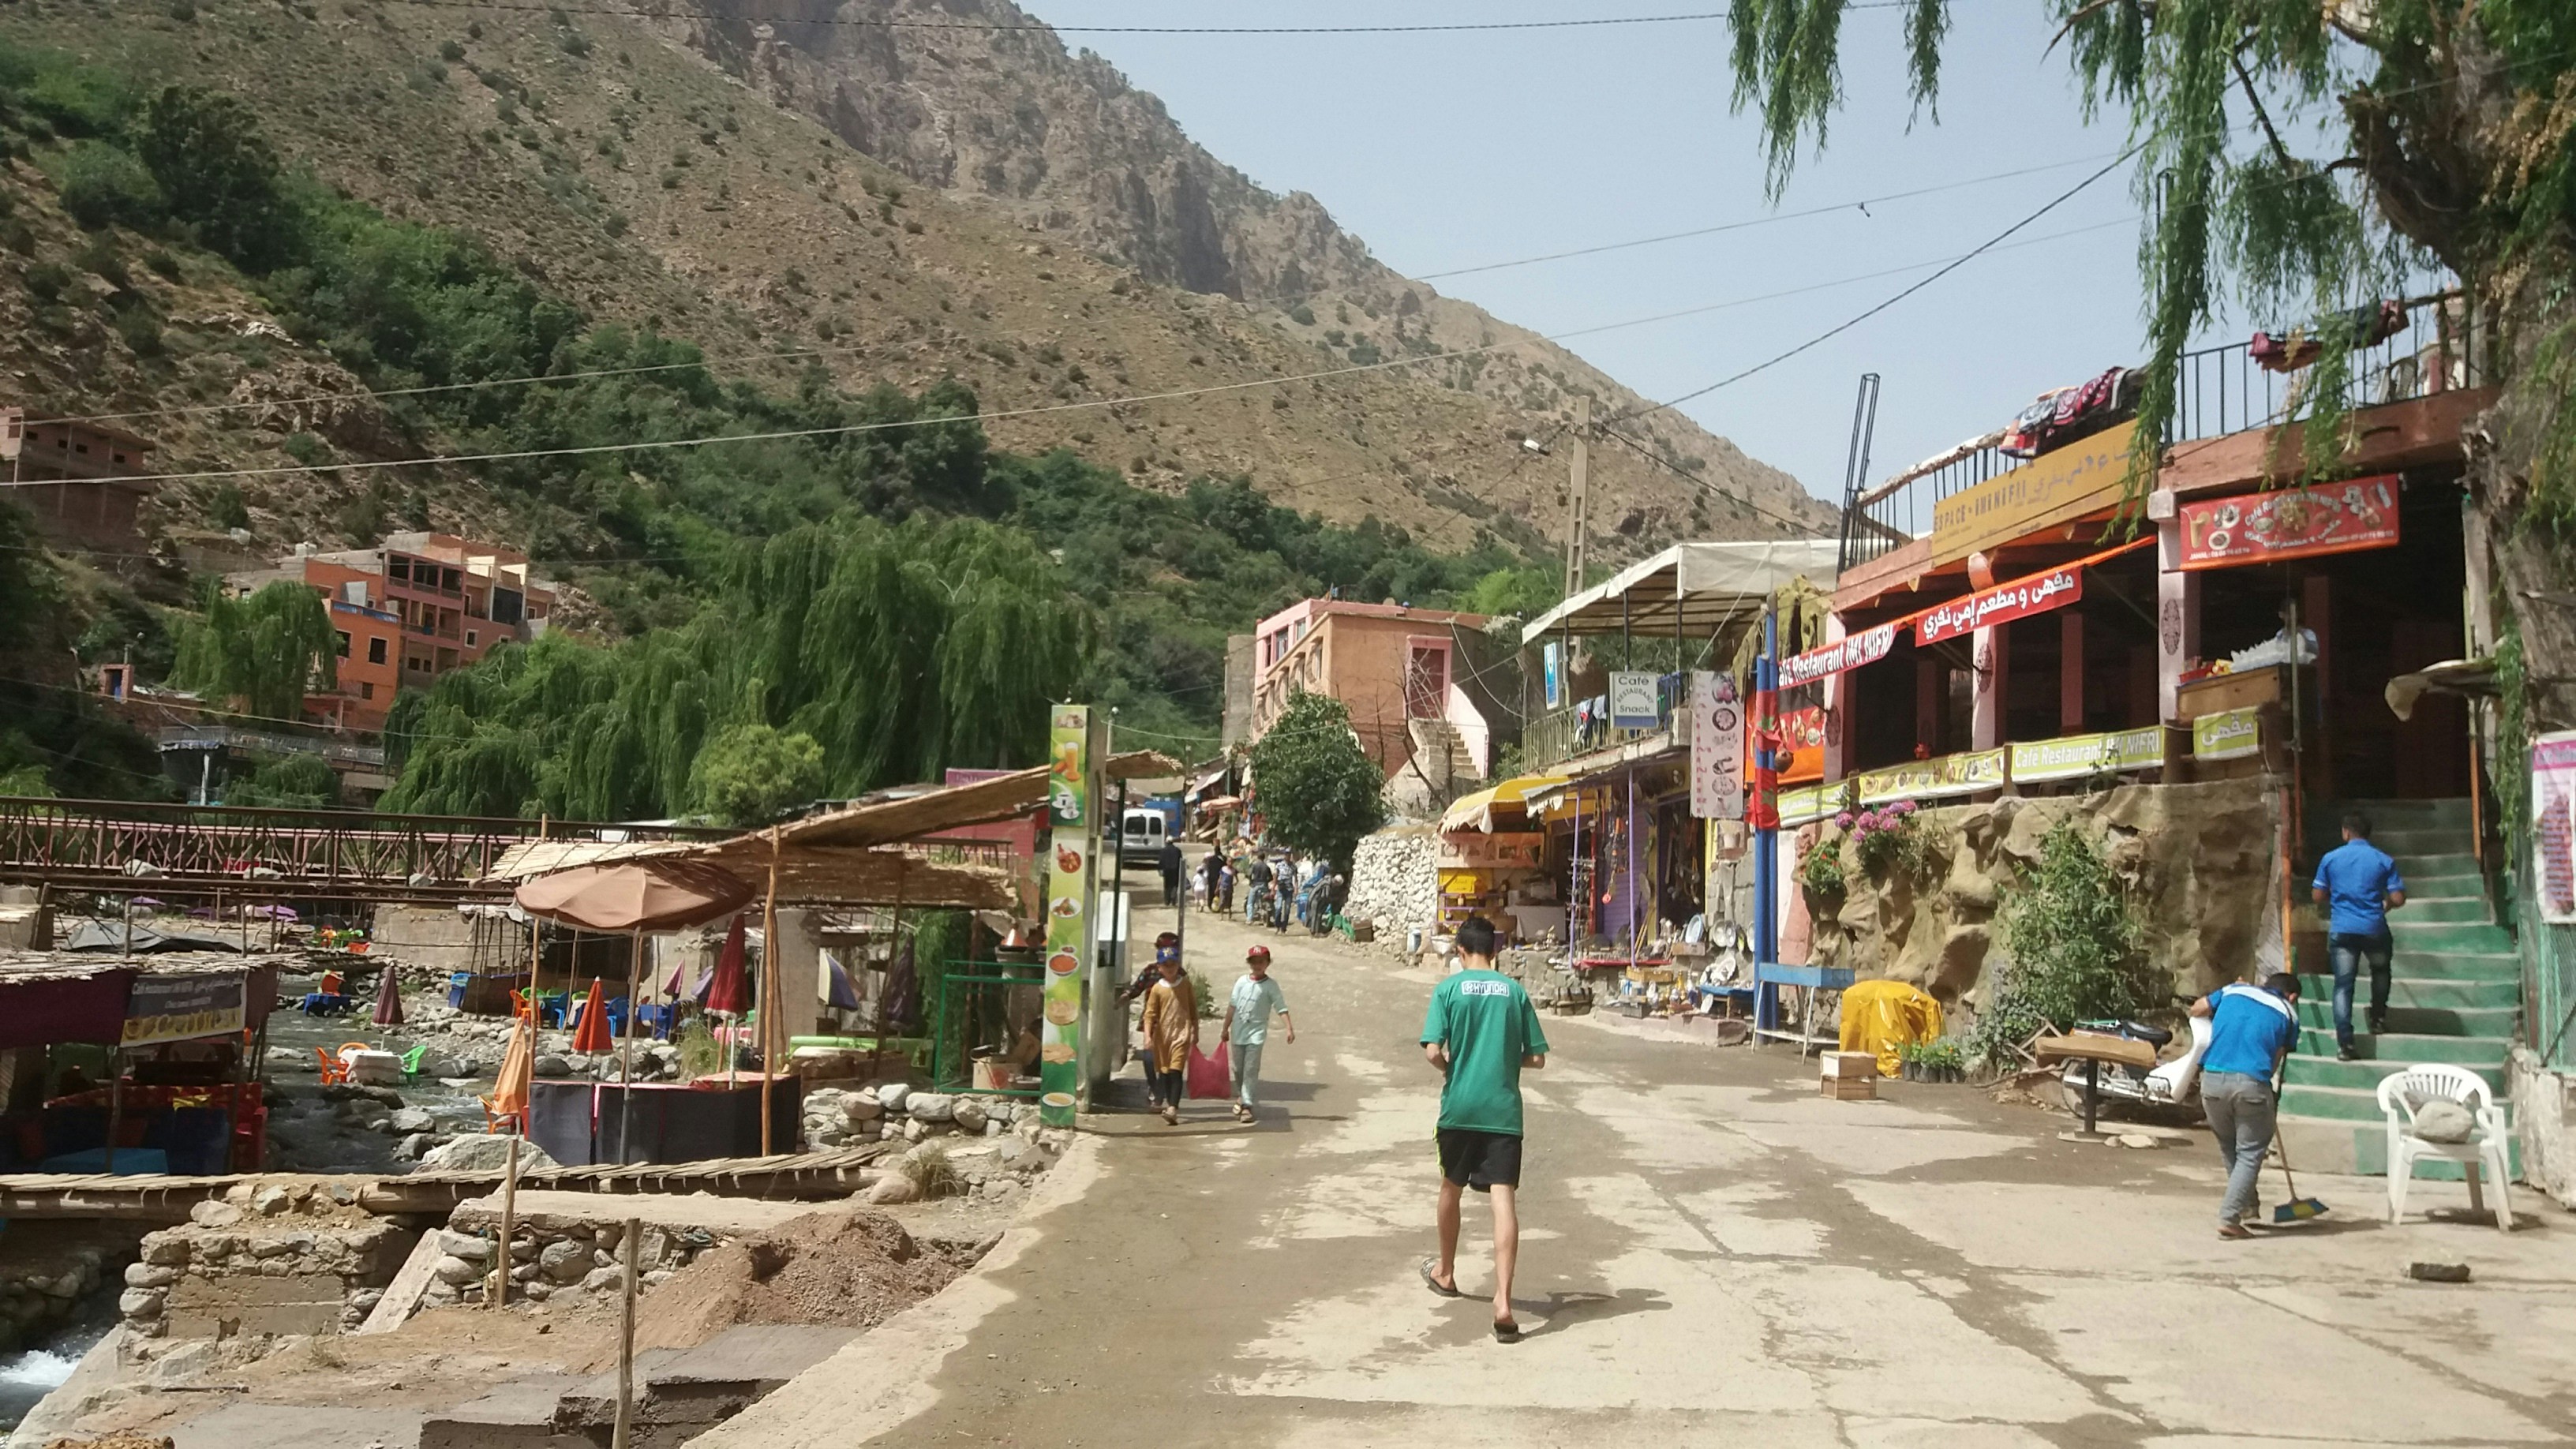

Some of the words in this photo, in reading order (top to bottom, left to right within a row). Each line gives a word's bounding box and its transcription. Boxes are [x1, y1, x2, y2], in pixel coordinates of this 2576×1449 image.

[2018, 586, 2027, 610] و
[2031, 571, 2074, 604] مقهى
[1923, 605, 1951, 640] نفري
[1952, 597, 1975, 633] إمي
[1976, 589, 2016, 626] مطعم
[1778, 658, 1794, 687] afé
[1792, 642, 1844, 683] Restaurant
[1864, 624, 1893, 661] NIFRI
[1616, 687, 1654, 704] RESTAURANT
[1618, 676, 1649, 686] Café
[1619, 705, 1650, 713] Snack
[2201, 714, 2254, 747] مقهى
[2015, 749, 2039, 768] Café
[2041, 740, 2102, 766] Restaurant
[2126, 731, 2160, 755] NIFRI
[1473, 983, 1507, 996] HYUNDAI
